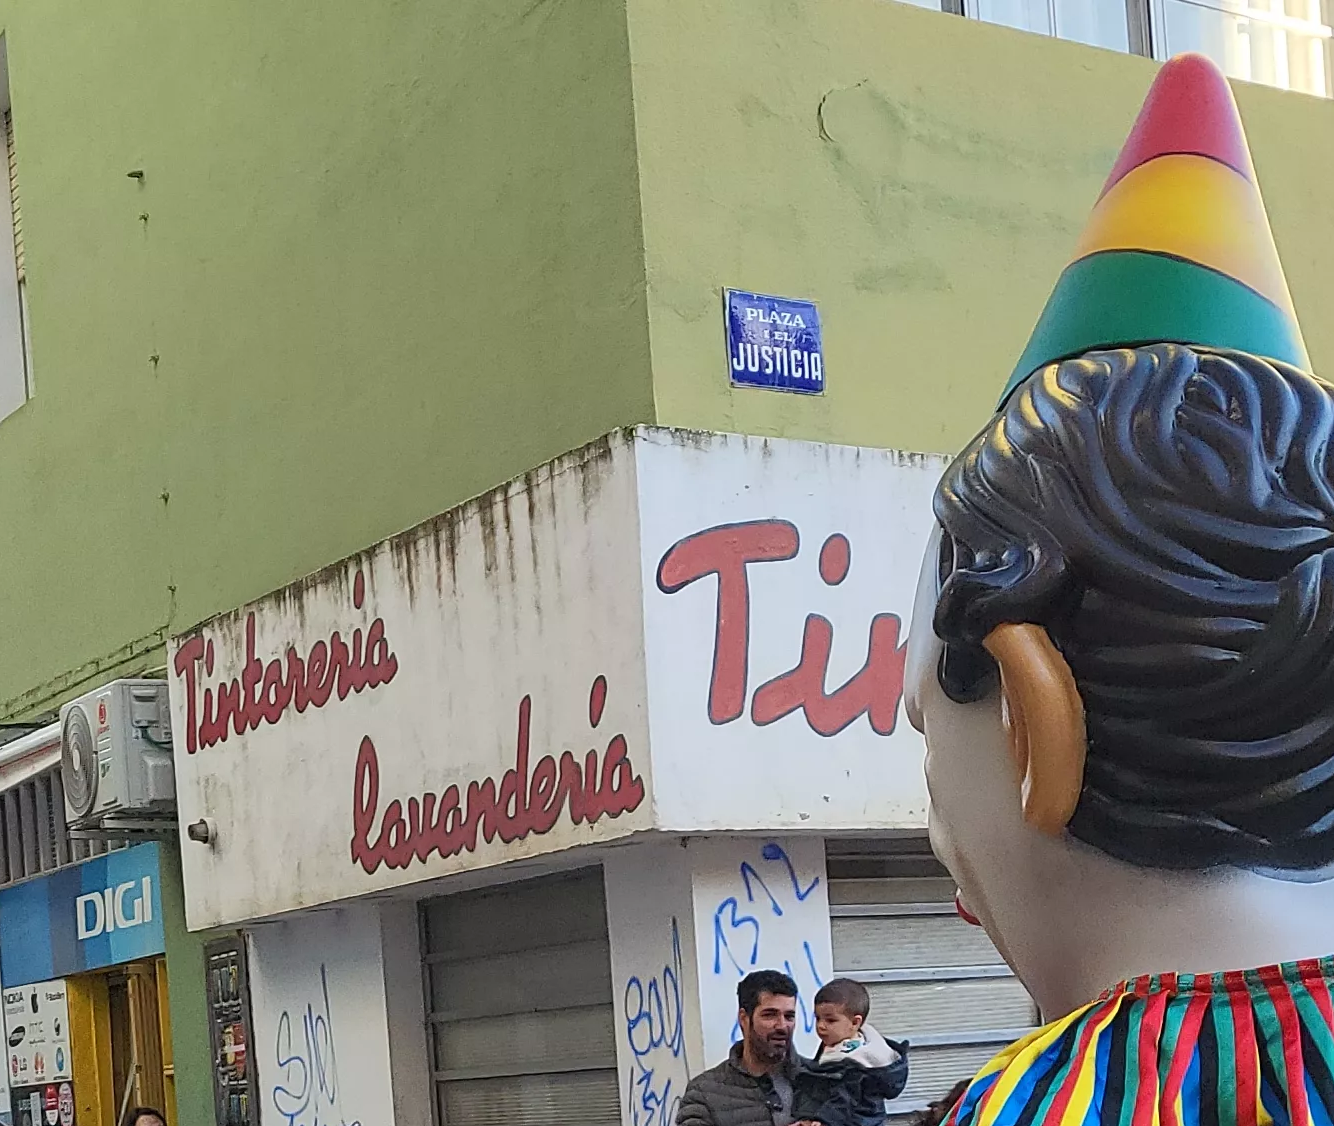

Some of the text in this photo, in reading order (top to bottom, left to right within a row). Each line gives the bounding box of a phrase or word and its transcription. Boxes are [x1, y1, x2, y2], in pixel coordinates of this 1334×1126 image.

[745, 307, 806, 328] PLAZA
[732, 343, 822, 381] JUSTICIA
[76, 875, 152, 940] DIGI
